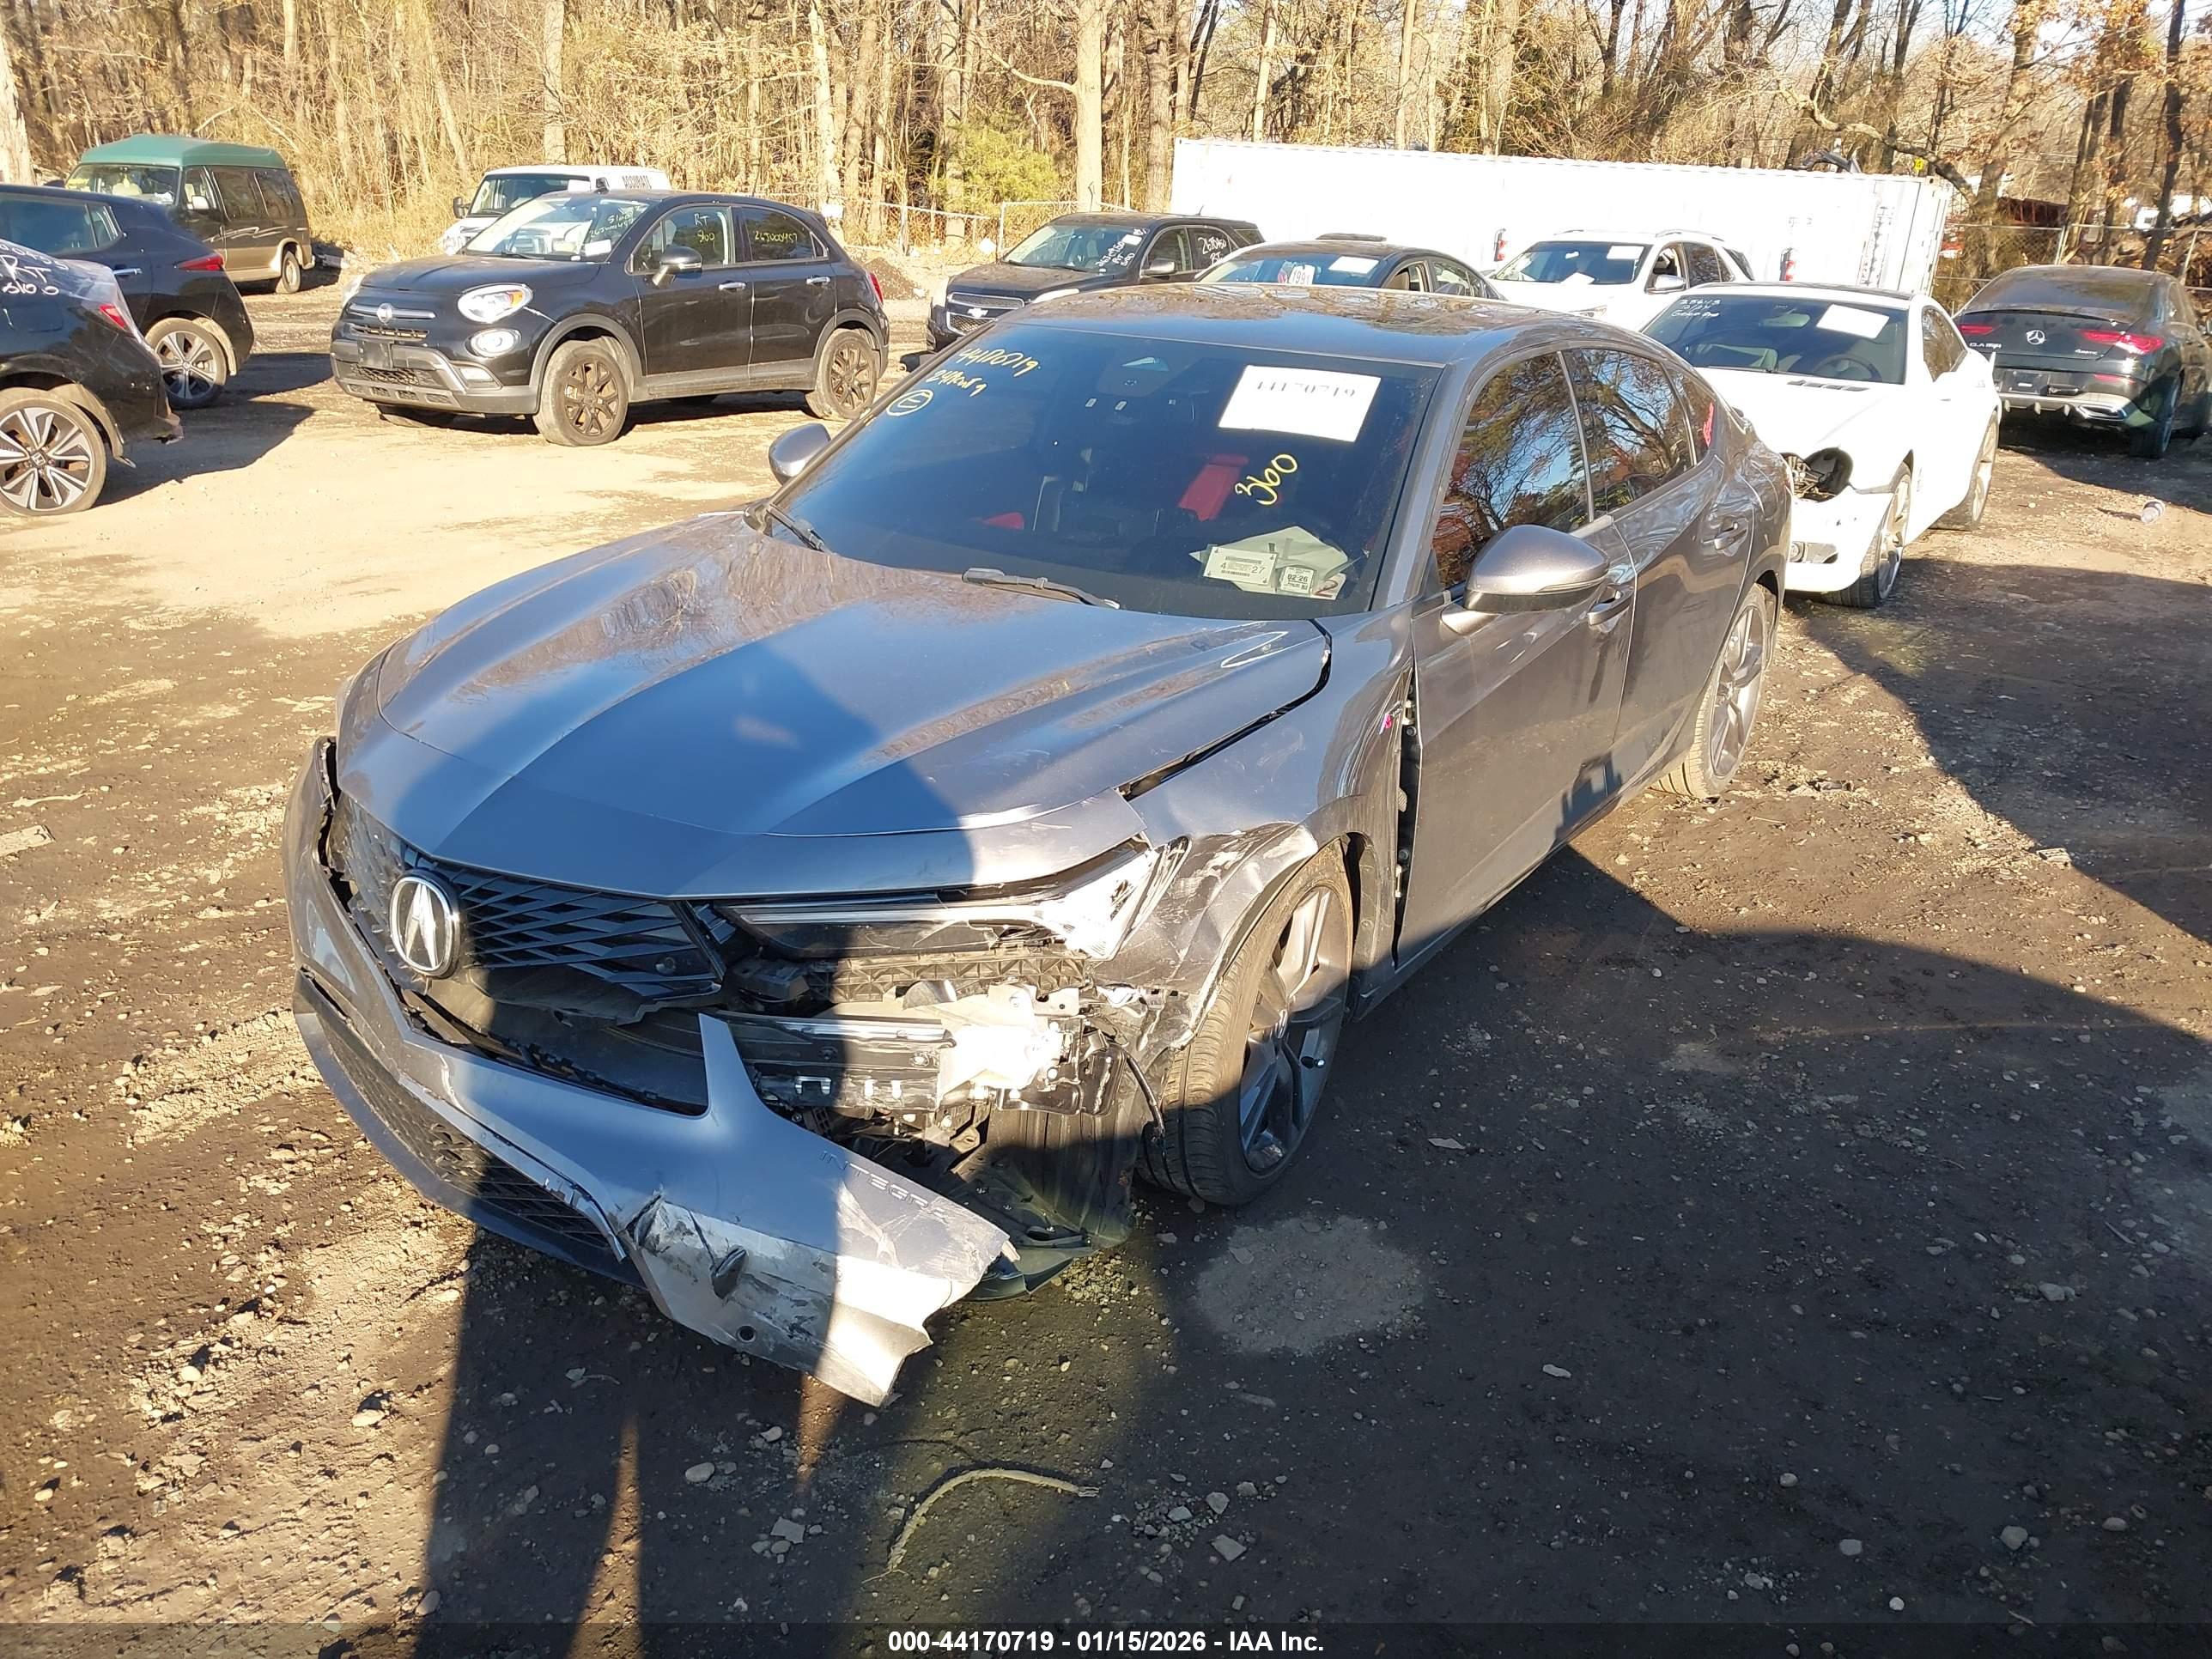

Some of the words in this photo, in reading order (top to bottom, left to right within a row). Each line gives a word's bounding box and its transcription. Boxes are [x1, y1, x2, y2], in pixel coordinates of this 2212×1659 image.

[1234, 453, 1298, 506] 360
[1252, 566, 1266, 574] 27
[820, 1150, 949, 1224] INTEGRA
